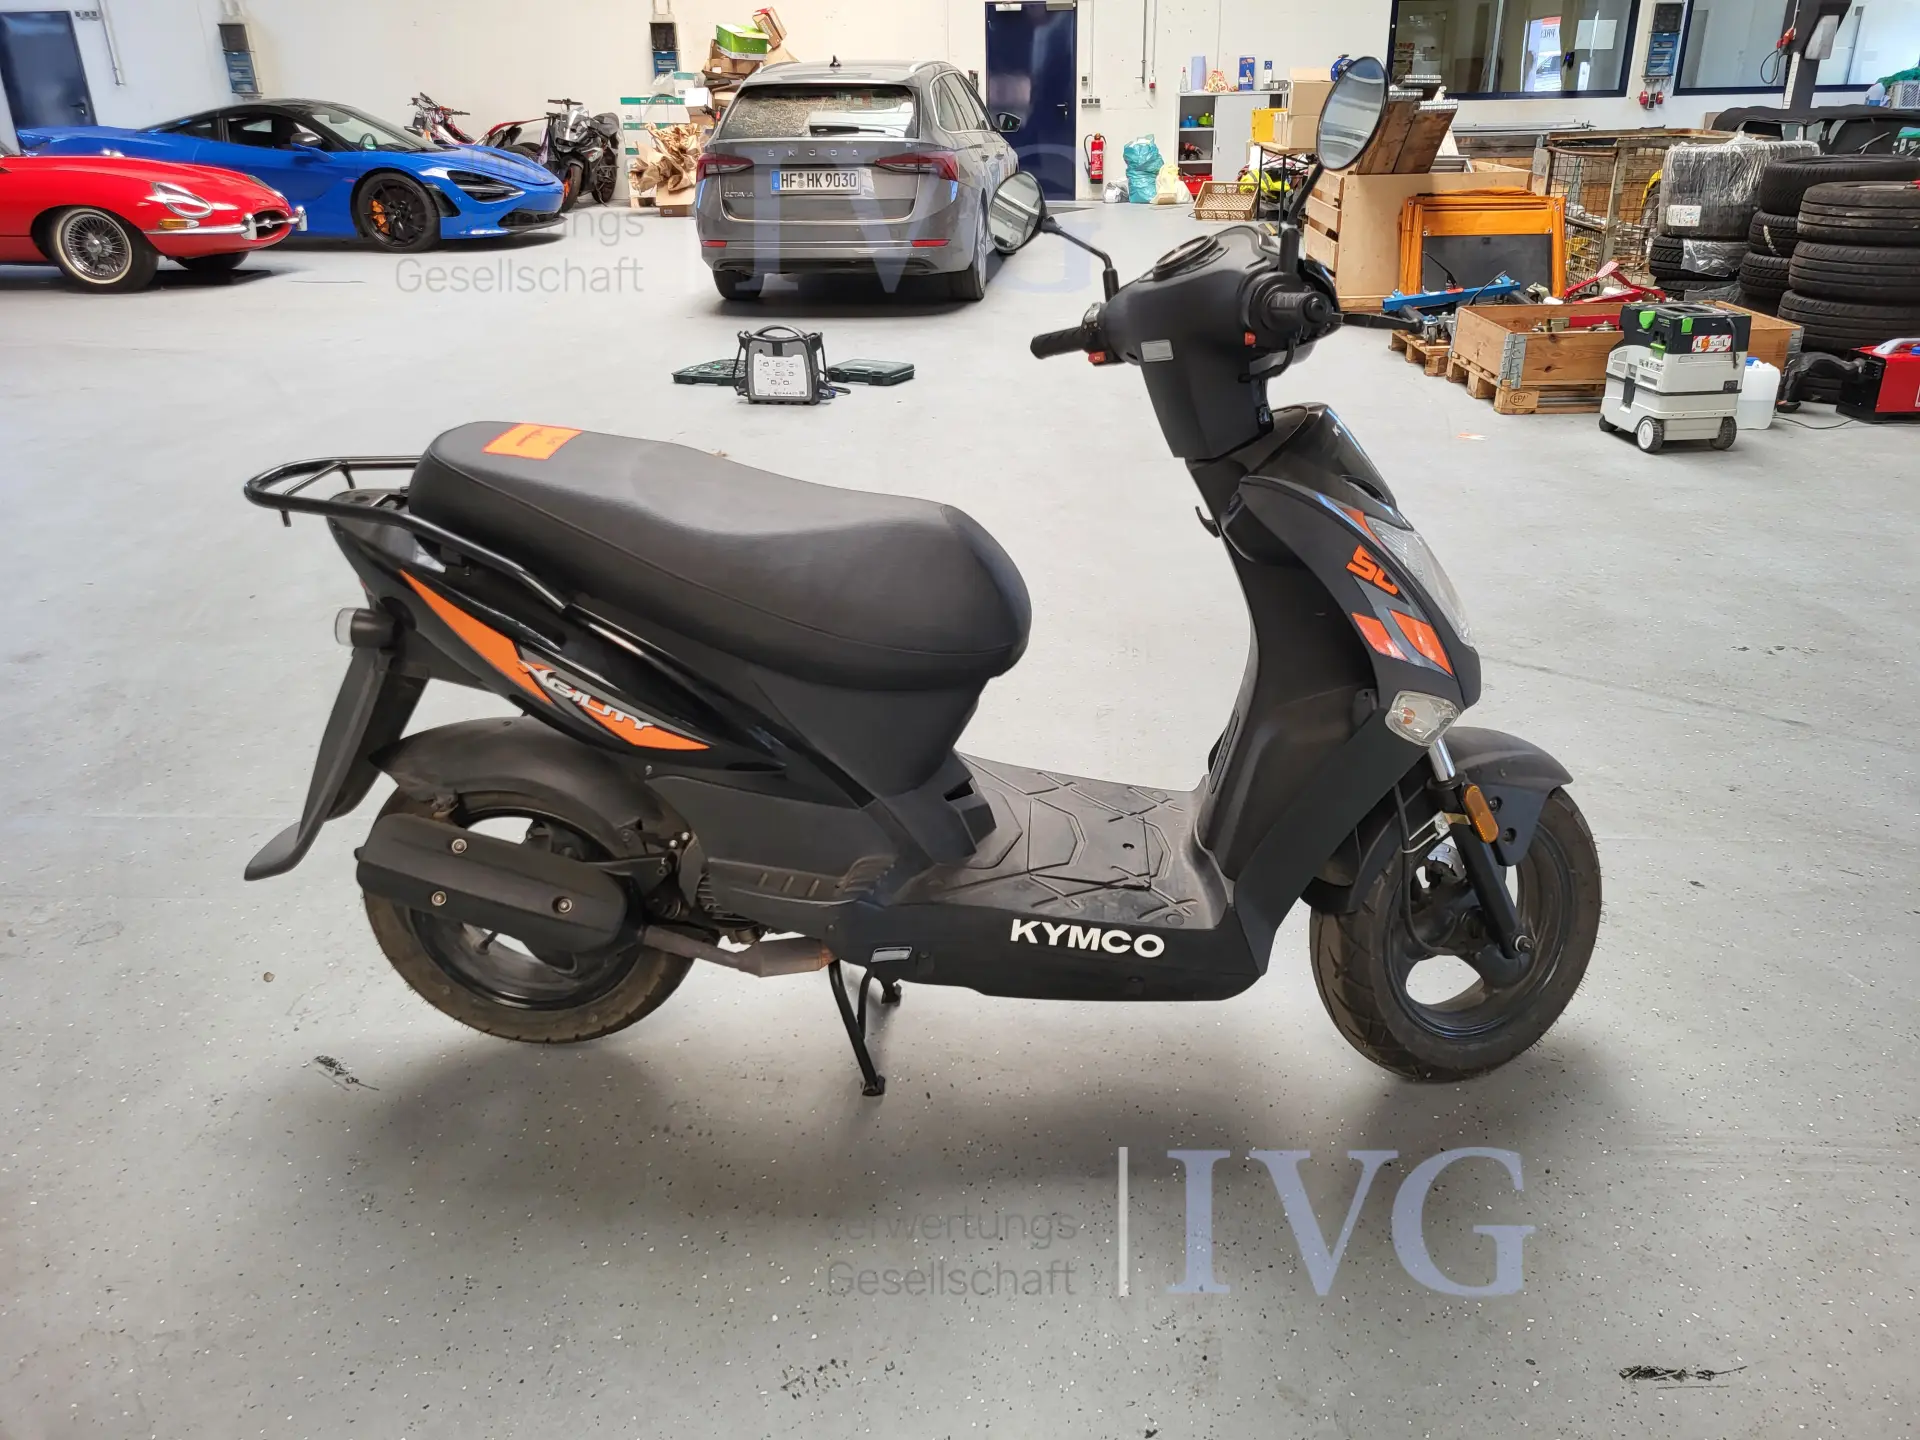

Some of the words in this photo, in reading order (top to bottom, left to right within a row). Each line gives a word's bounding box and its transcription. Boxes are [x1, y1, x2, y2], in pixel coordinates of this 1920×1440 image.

[781, 173, 797, 188] HF
[806, 172, 823, 188] HK
[825, 172, 857, 188] 9030
[1010, 918, 1165, 958] KYMCO
